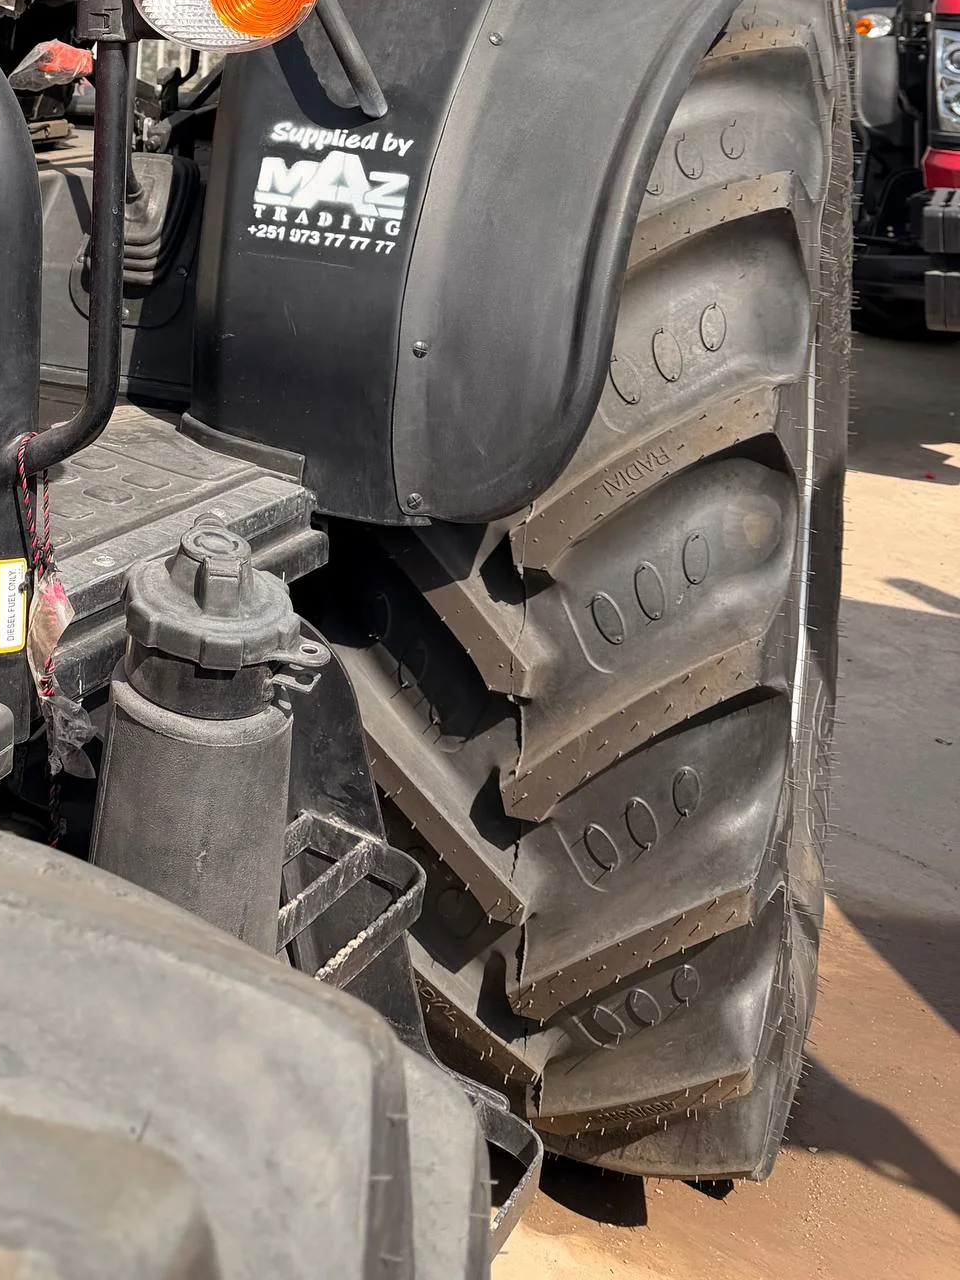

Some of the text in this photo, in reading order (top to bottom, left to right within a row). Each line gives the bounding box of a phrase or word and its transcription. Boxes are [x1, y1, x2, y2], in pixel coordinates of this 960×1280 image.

[270, 122, 414, 157] Supplied by
[253, 204, 400, 236] TRADING
[247, 224, 396, 255] +251 973 77 77 77
[598, 446, 672, 498] RADIAL
[7, 592, 16, 613] FUEL
[6, 614, 16, 642] DIESEL
